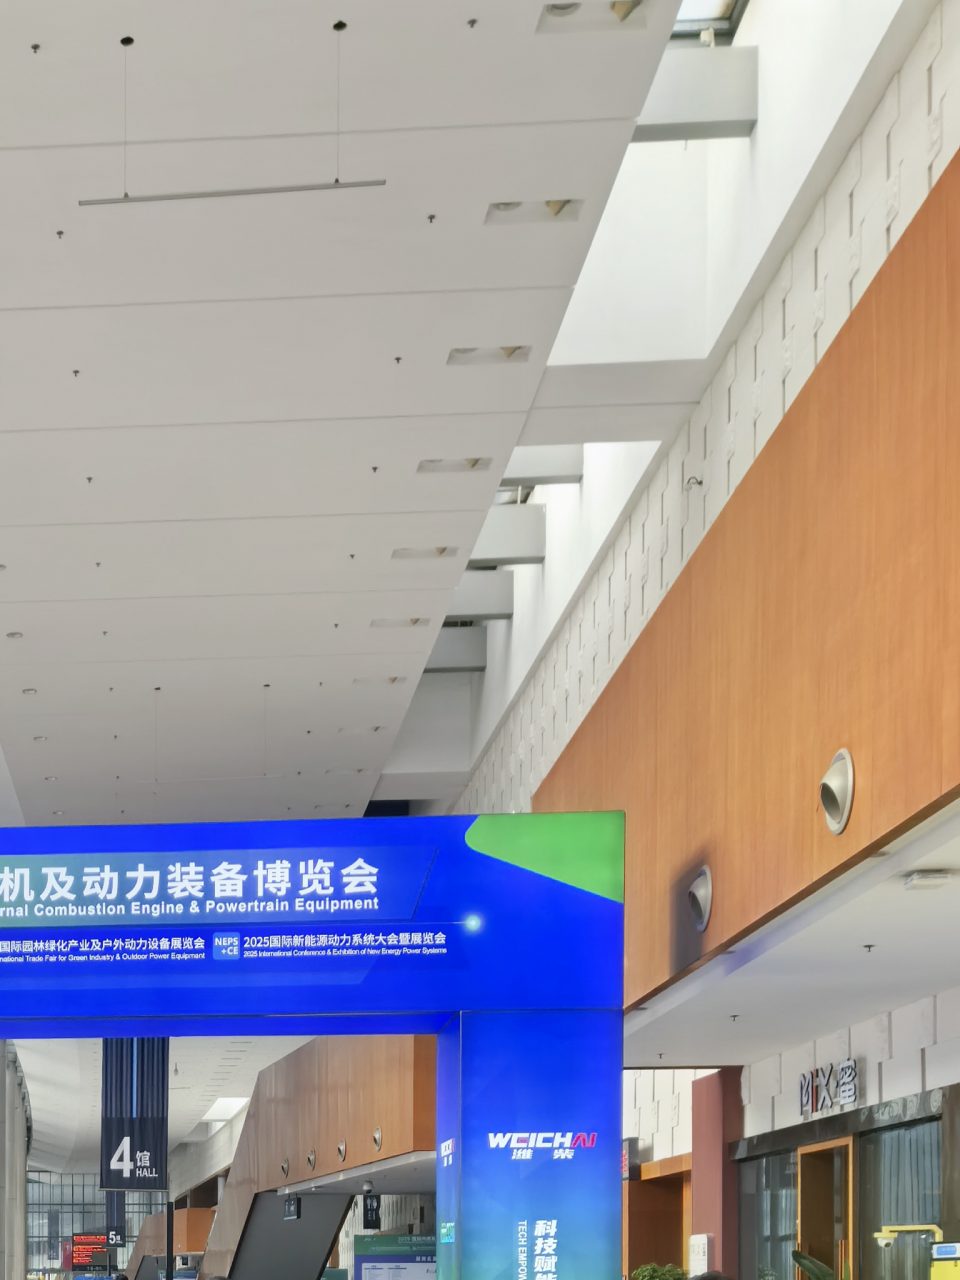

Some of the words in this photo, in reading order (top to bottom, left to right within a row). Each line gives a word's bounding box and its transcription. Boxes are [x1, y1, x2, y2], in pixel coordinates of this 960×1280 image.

[34, 902, 126, 916] Combustion
[131, 901, 184, 917] Engine
[189, 900, 200, 914] &
[206, 899, 289, 913] Powertrain
[295, 897, 379, 913] Equipment
[214, 937, 239, 946] NEPS
[243, 931, 447, 948] 2025国际新能源动力系统大会暨展览会
[221, 946, 239, 955] +CE
[258, 949, 292, 957] International
[402, 947, 422, 955] Power
[44, 954, 57, 962] Fair
[58, 954, 67, 962] for
[68, 954, 88, 962] Green
[89, 953, 115, 962] Industry
[122, 952, 148, 961] Outdoor
[149, 952, 169, 960] Power
[171, 952, 206, 961] Equipment
[488, 1132, 597, 1148] WEICHAI
[136, 1167, 159, 1178] HALL
[517, 1220, 528, 1246] TECH
